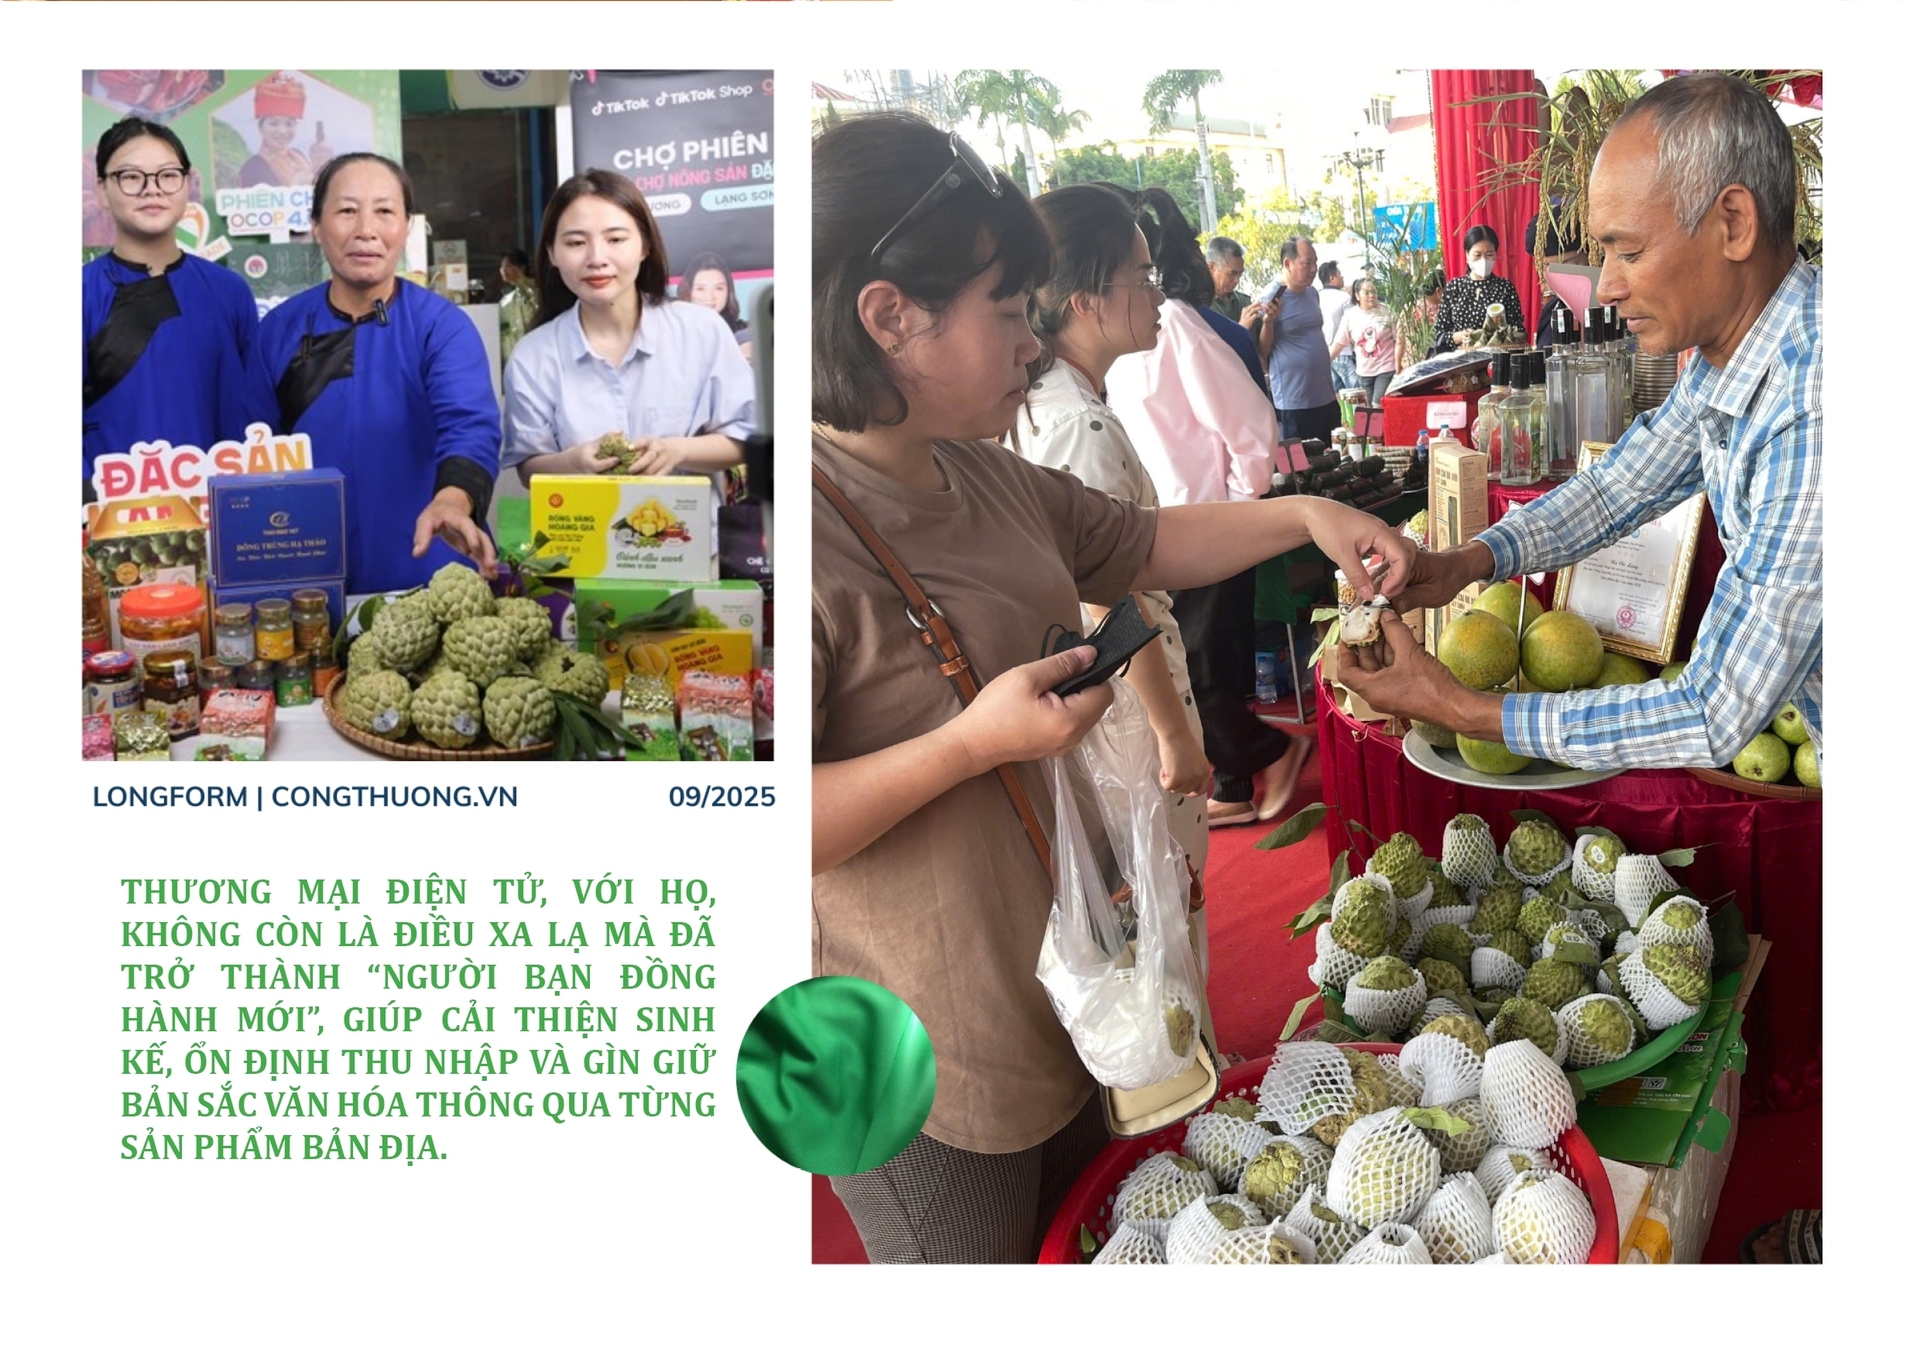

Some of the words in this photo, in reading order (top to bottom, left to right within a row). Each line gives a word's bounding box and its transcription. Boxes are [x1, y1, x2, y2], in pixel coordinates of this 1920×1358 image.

[669, 88, 717, 105] TikTok
[719, 84, 753, 99] Shop
[606, 98, 650, 114] TikTok
[613, 141, 676, 171] CHỢ
[682, 130, 768, 163] PHIÊN
[668, 167, 711, 187] NÔNG
[714, 161, 748, 182] SẢN
[751, 159, 774, 180] ĐẶ
[222, 189, 285, 209] PHIÊN
[290, 190, 315, 207] CH
[230, 211, 285, 228] OCOP
[214, 430, 306, 475] SẢN
